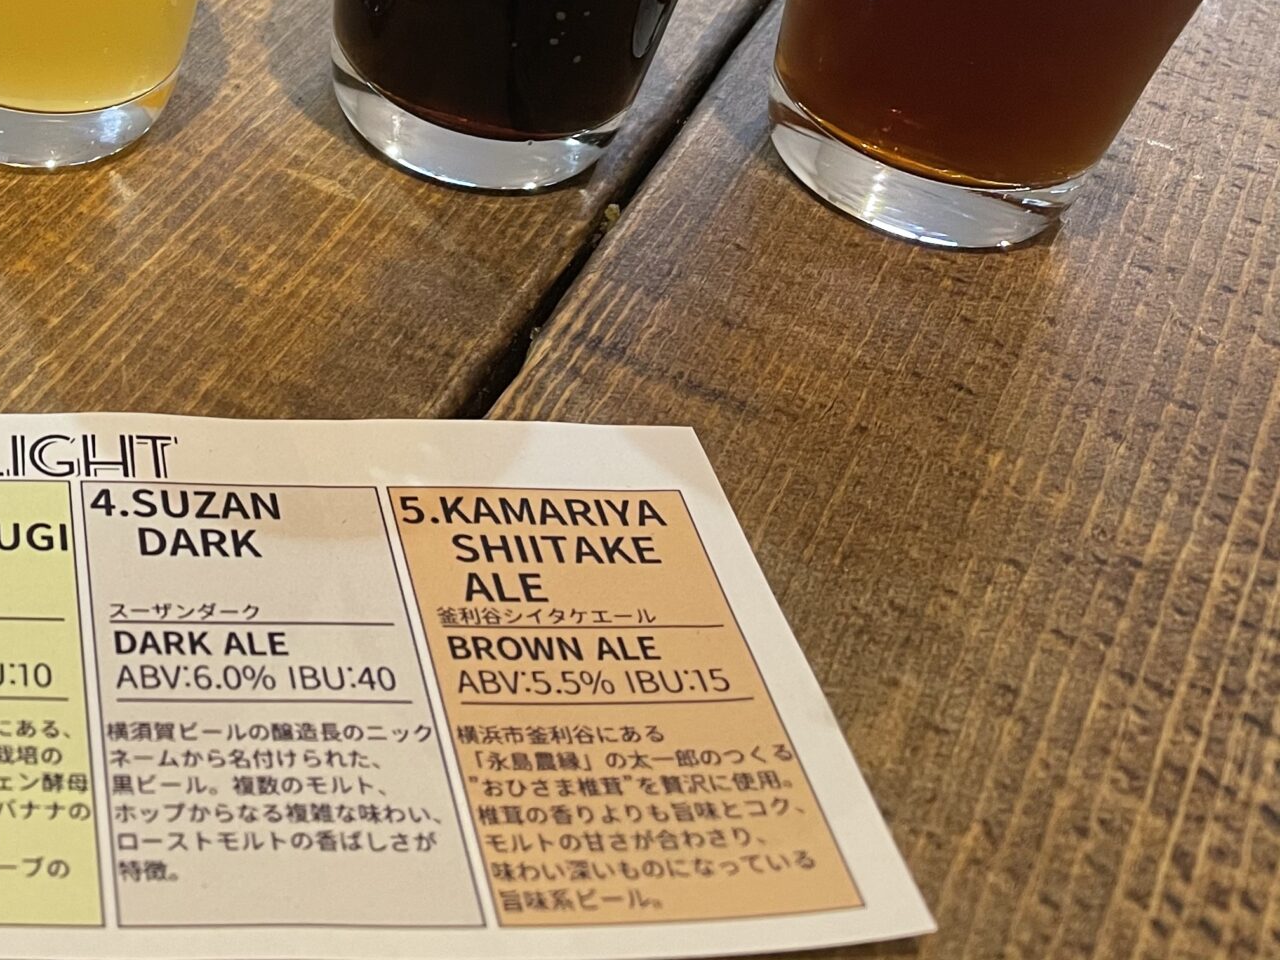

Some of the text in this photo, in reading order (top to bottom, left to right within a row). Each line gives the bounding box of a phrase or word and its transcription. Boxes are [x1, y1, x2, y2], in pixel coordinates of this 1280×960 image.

[90, 490, 282, 520] 4.SUZAN
[400, 495, 668, 527] 5.KAMARIYA
[138, 528, 263, 557] DARK
[454, 534, 662, 564] SHIITAKE
[464, 573, 550, 603] ALE
[114, 632, 289, 656] DARK ALE
[447, 635, 662, 661] BROWN ALE
[116, 664, 397, 691] ABV:6.0% IBU:40
[457, 666, 731, 696] ABV:5.5% IBU:15
